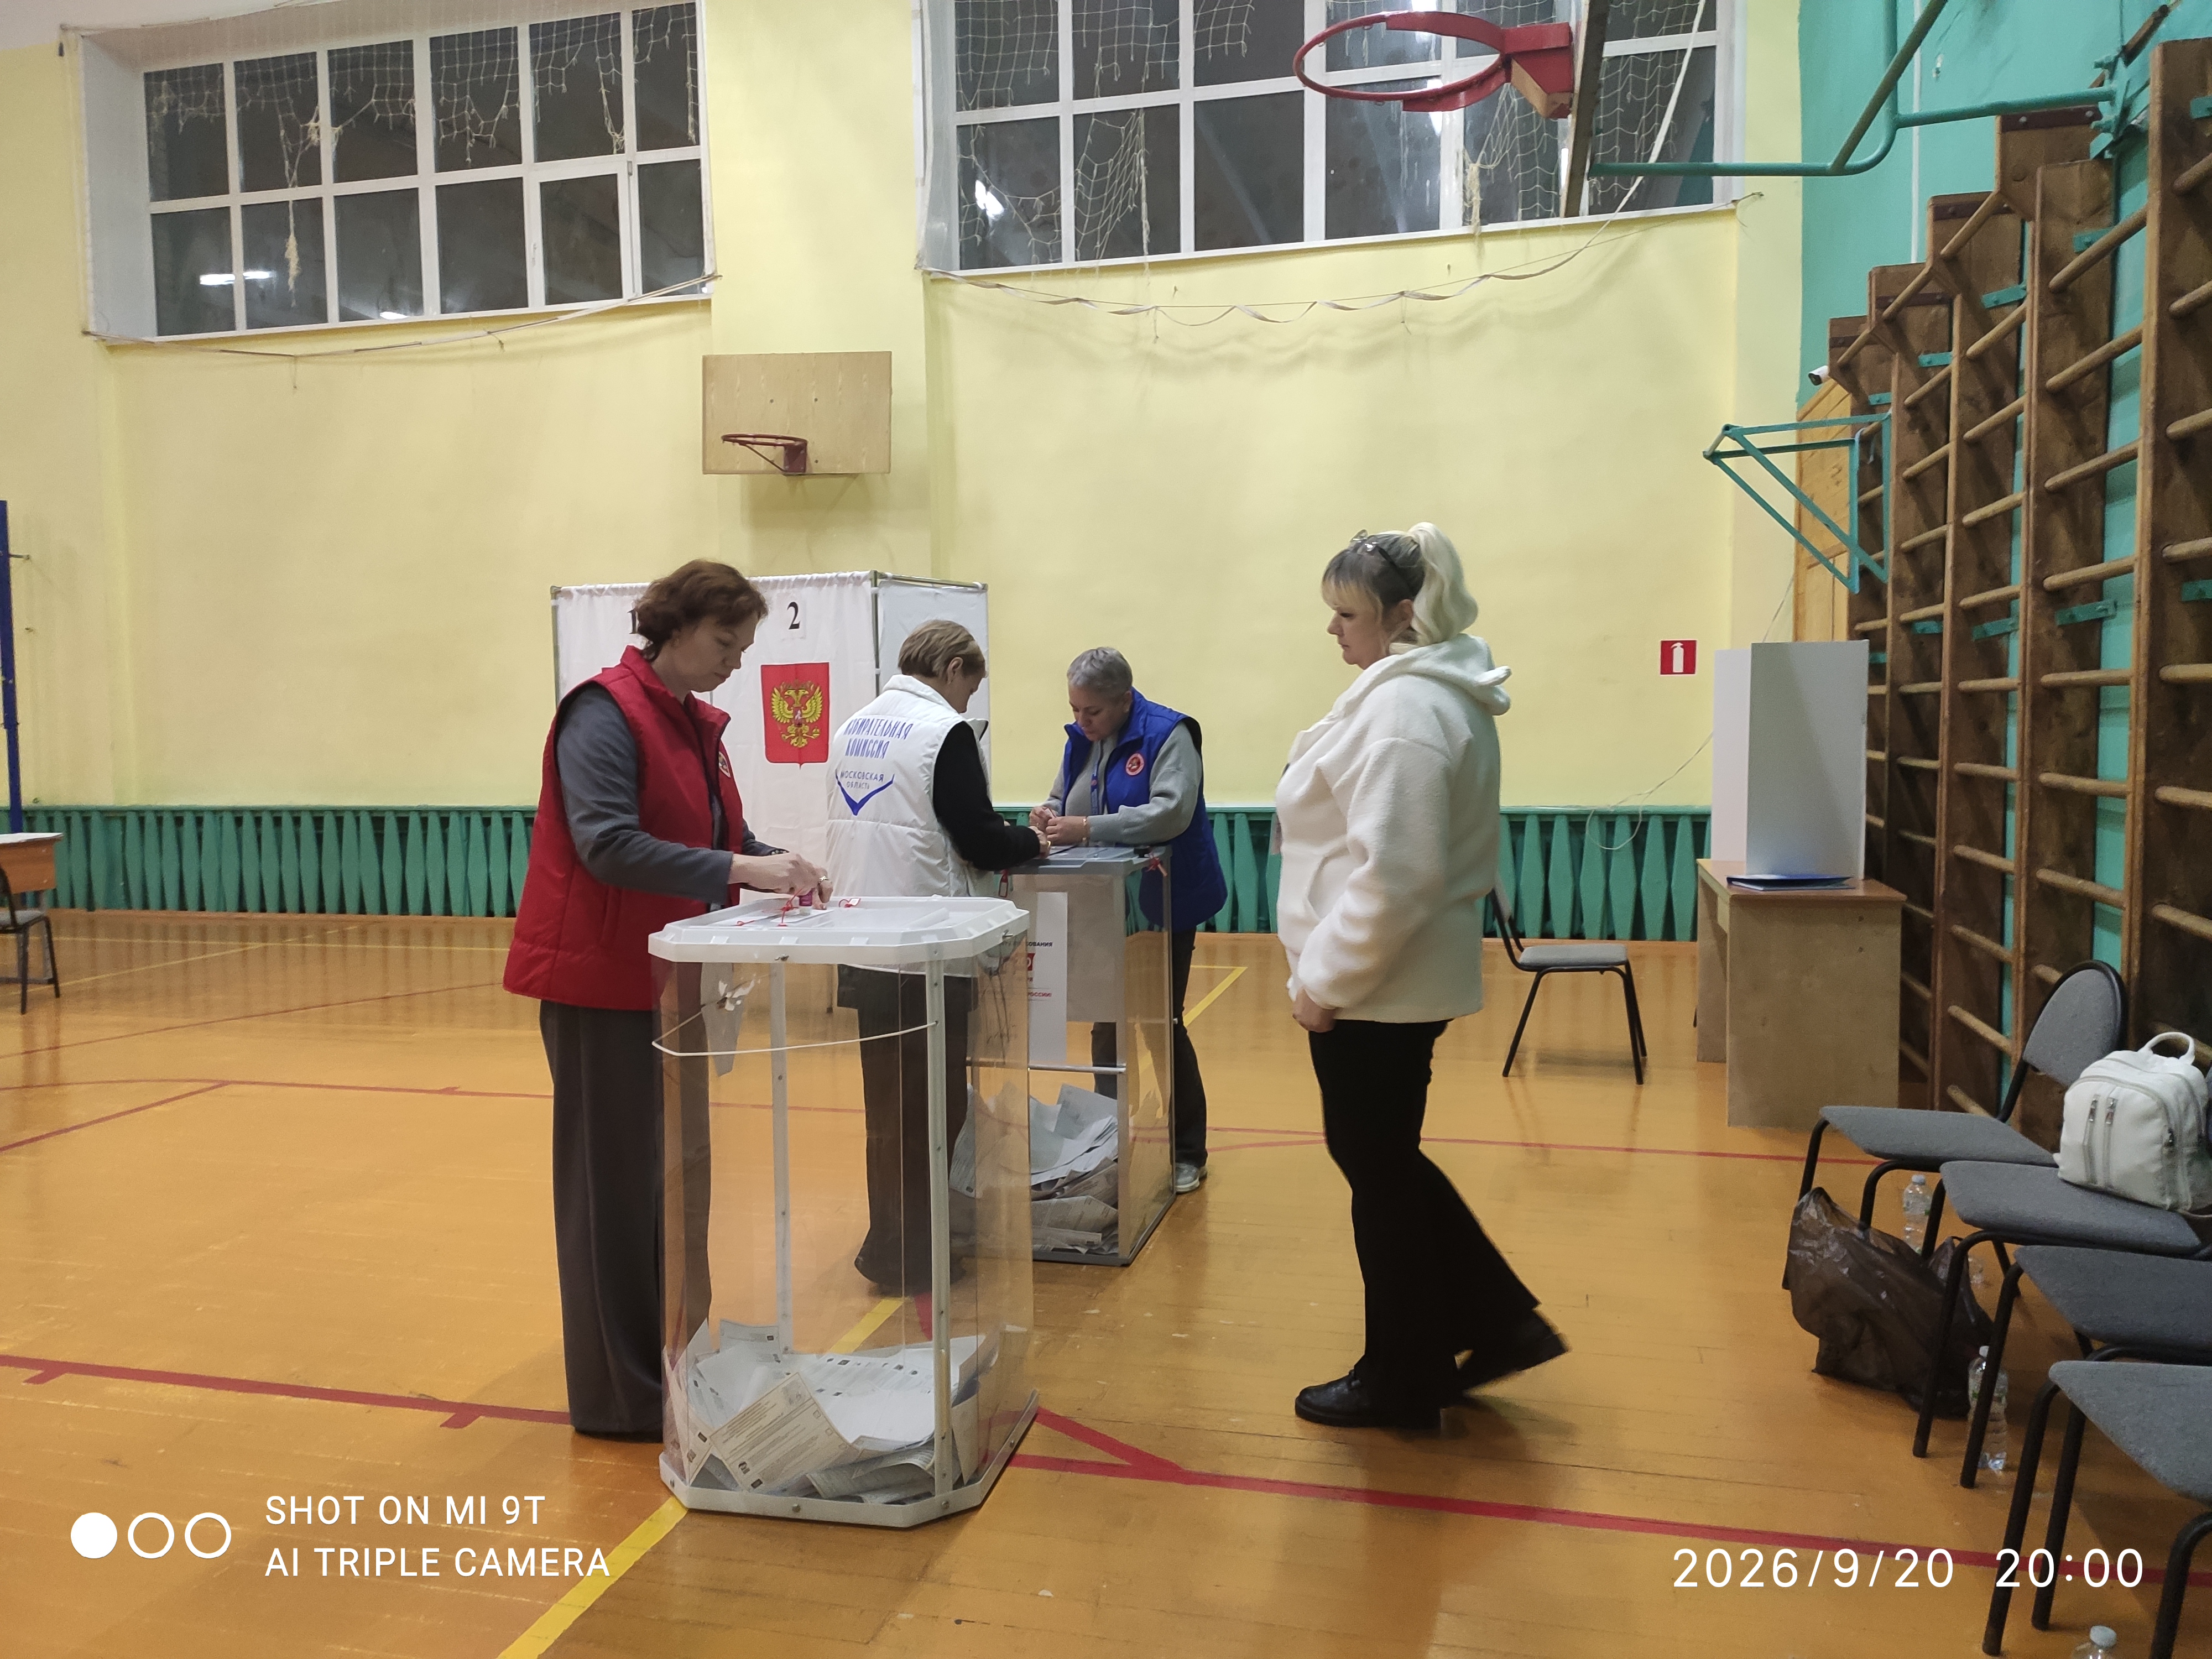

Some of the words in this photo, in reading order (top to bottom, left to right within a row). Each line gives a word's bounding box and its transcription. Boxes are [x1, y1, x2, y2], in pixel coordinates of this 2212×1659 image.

[787, 601, 801, 630] 2
[843, 718, 914, 740] ИЗБИРАТЕЛЬНАЯ
[845, 738, 890, 759] КОМИССИЯ
[840, 770, 884, 782] МОСКОВСКАЯ
[846, 781, 870, 790] ОБЛАСТЬ
